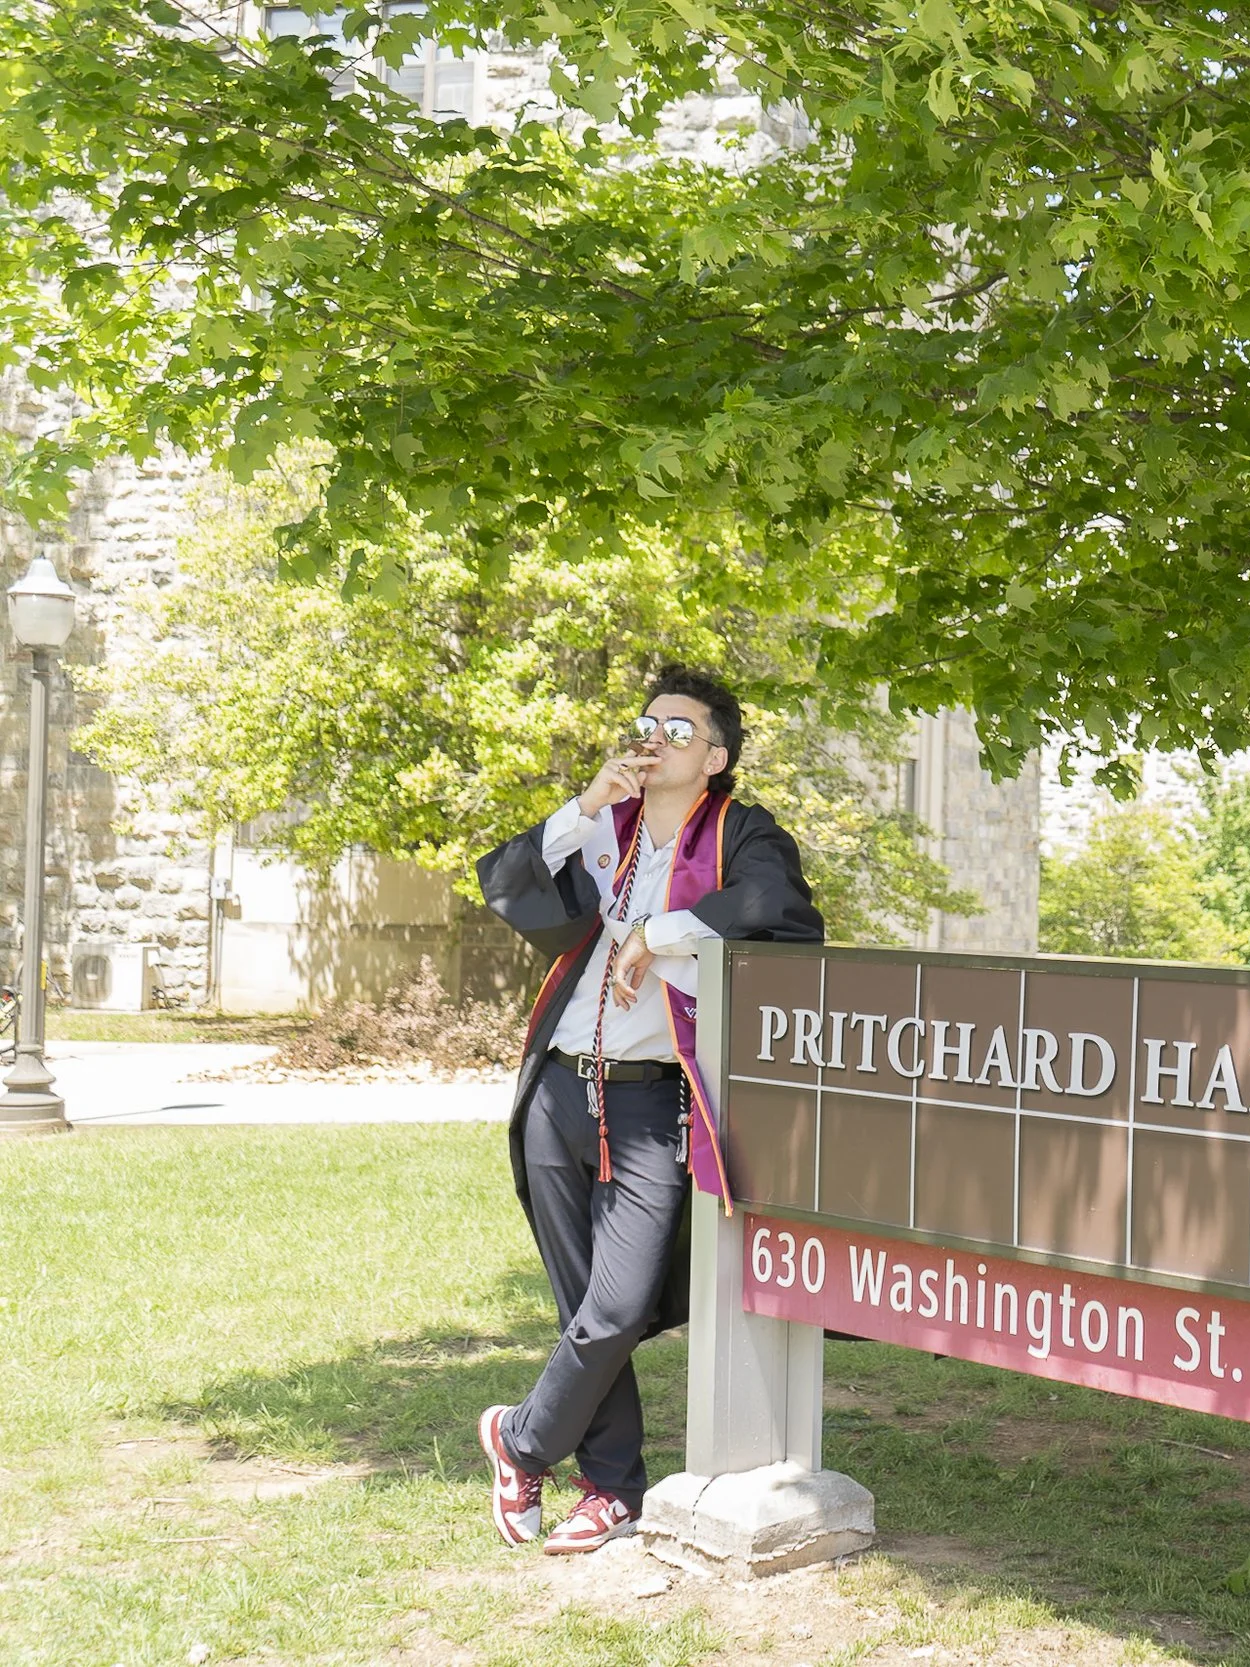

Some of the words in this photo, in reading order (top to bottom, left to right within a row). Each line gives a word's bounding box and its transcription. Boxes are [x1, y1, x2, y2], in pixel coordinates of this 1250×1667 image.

[756, 1005, 1117, 1097] PRITCHARD
[751, 1227, 826, 1294] 630
[849, 1244, 1145, 1360] Washington
[1173, 1306, 1243, 1383] St.
